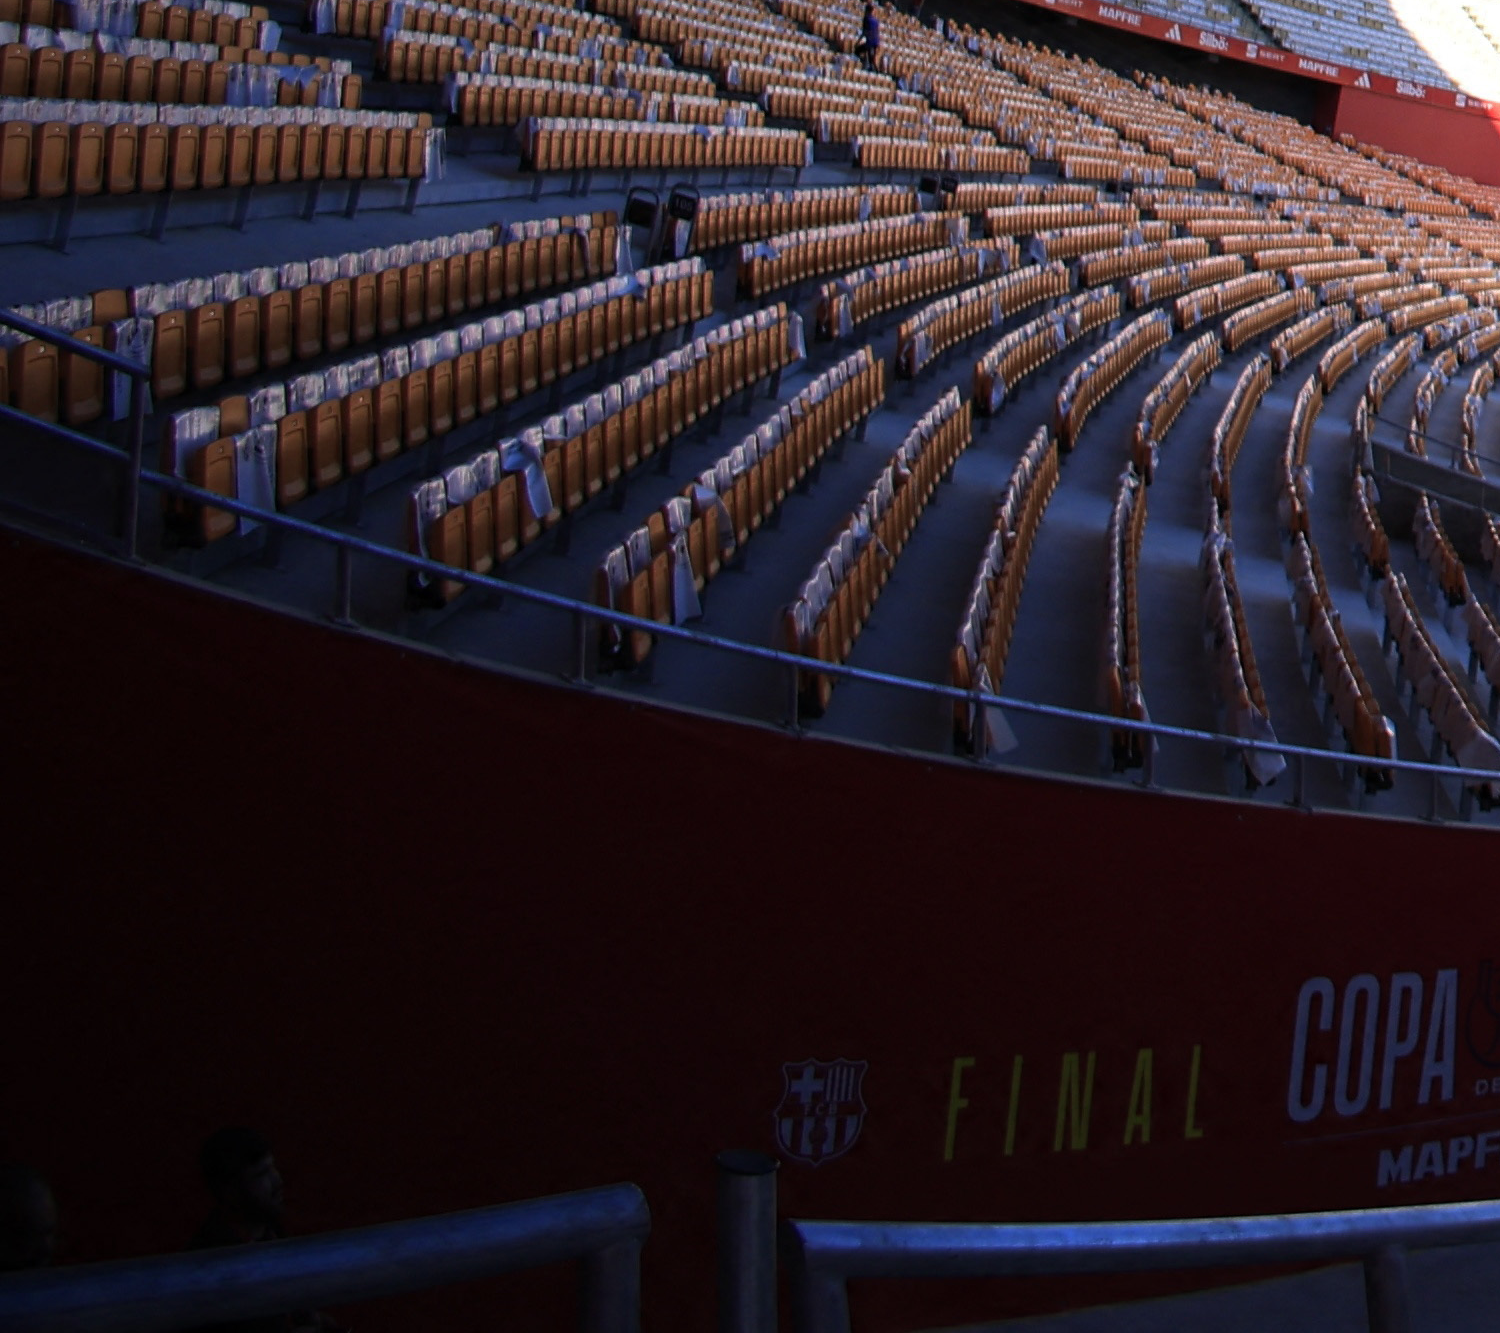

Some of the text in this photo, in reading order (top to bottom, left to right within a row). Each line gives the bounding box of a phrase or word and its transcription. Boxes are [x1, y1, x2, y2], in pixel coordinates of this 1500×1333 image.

[1099, 4, 1142, 27] MAPFRE
[1298, 57, 1340, 78] MAPFRE
[943, 1043, 1203, 1162] FINAL
[1286, 968, 1459, 1123] COPA
